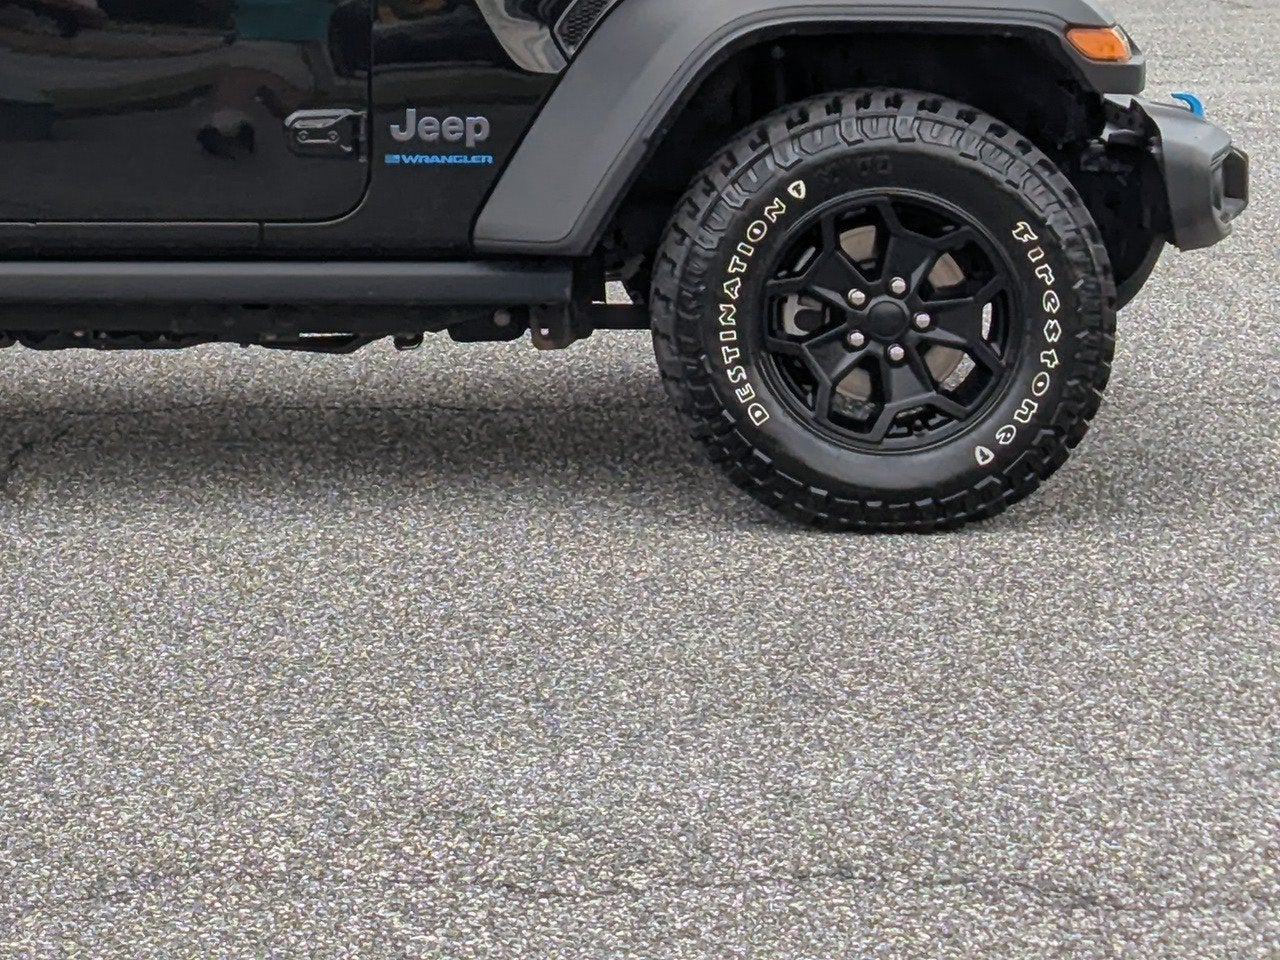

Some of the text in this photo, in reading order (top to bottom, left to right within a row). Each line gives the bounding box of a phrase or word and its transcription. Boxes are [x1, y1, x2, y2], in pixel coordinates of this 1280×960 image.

[389, 107, 490, 148] Jeep
[401, 153, 494, 164] WRANGLER
[718, 197, 787, 427] DESTINATION
